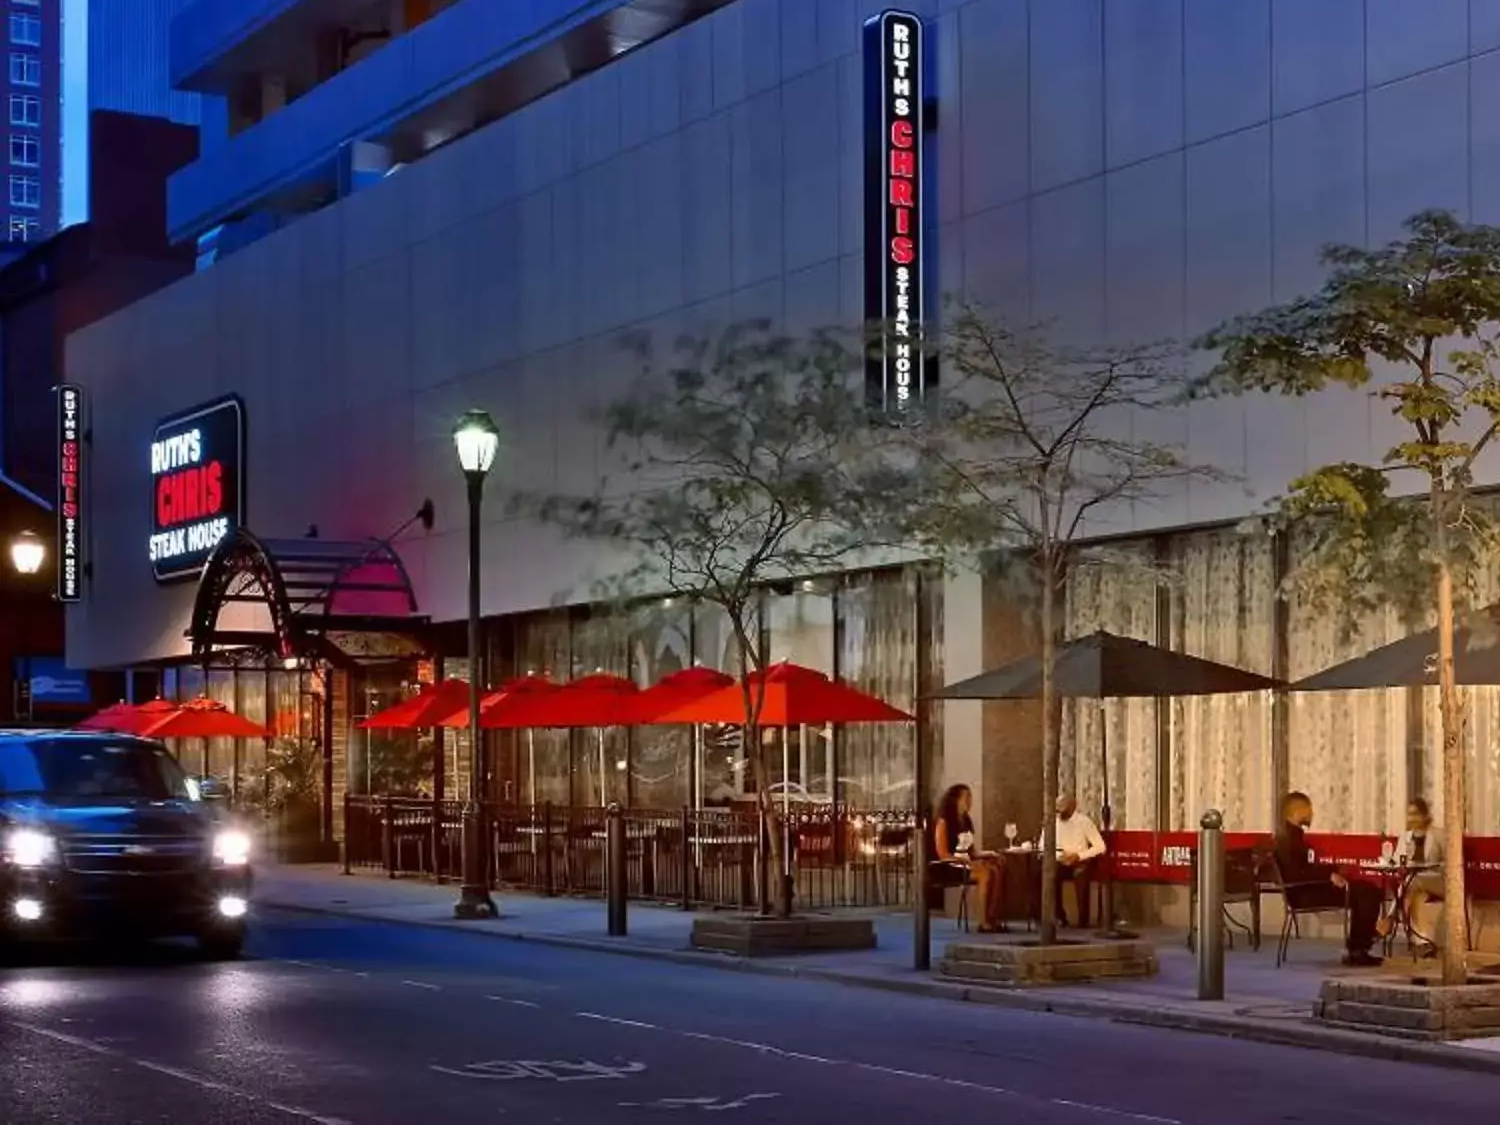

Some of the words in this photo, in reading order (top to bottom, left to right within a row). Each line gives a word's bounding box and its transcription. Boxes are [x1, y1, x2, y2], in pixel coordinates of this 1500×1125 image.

[889, 120, 914, 264] CHRIS
[151, 429, 201, 473] RUTH'S
[157, 460, 222, 527] CHRIS
[149, 528, 186, 561] STEAK
[188, 517, 228, 551] HOUSE
